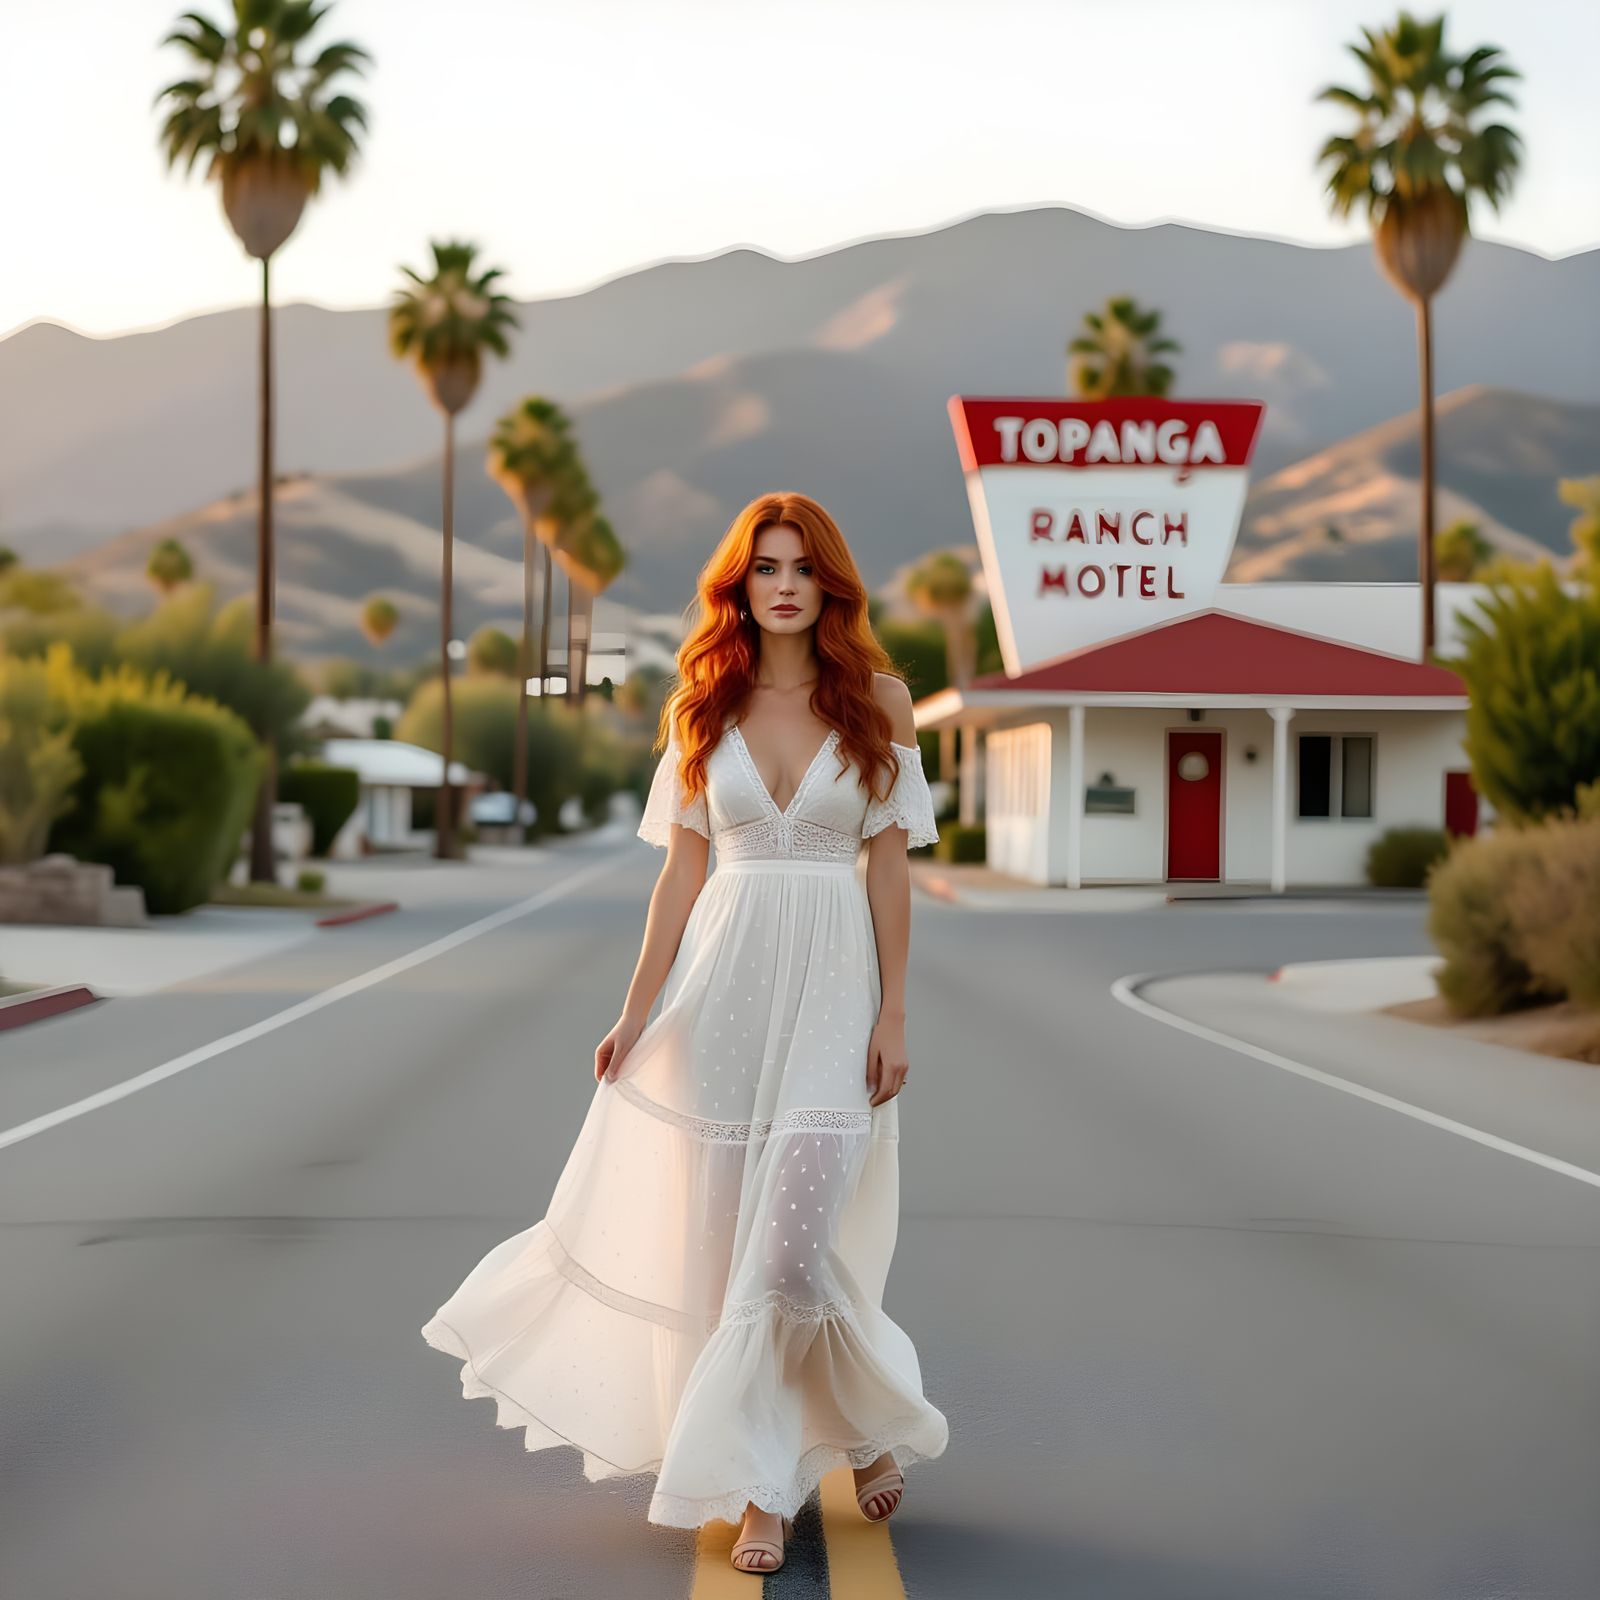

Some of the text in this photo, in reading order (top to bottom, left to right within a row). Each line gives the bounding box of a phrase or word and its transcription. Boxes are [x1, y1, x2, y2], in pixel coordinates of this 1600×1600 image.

[993, 416, 1226, 464] TOPANGA
[1031, 509, 1188, 546] RANCH
[1039, 564, 1185, 599] MOTEL
